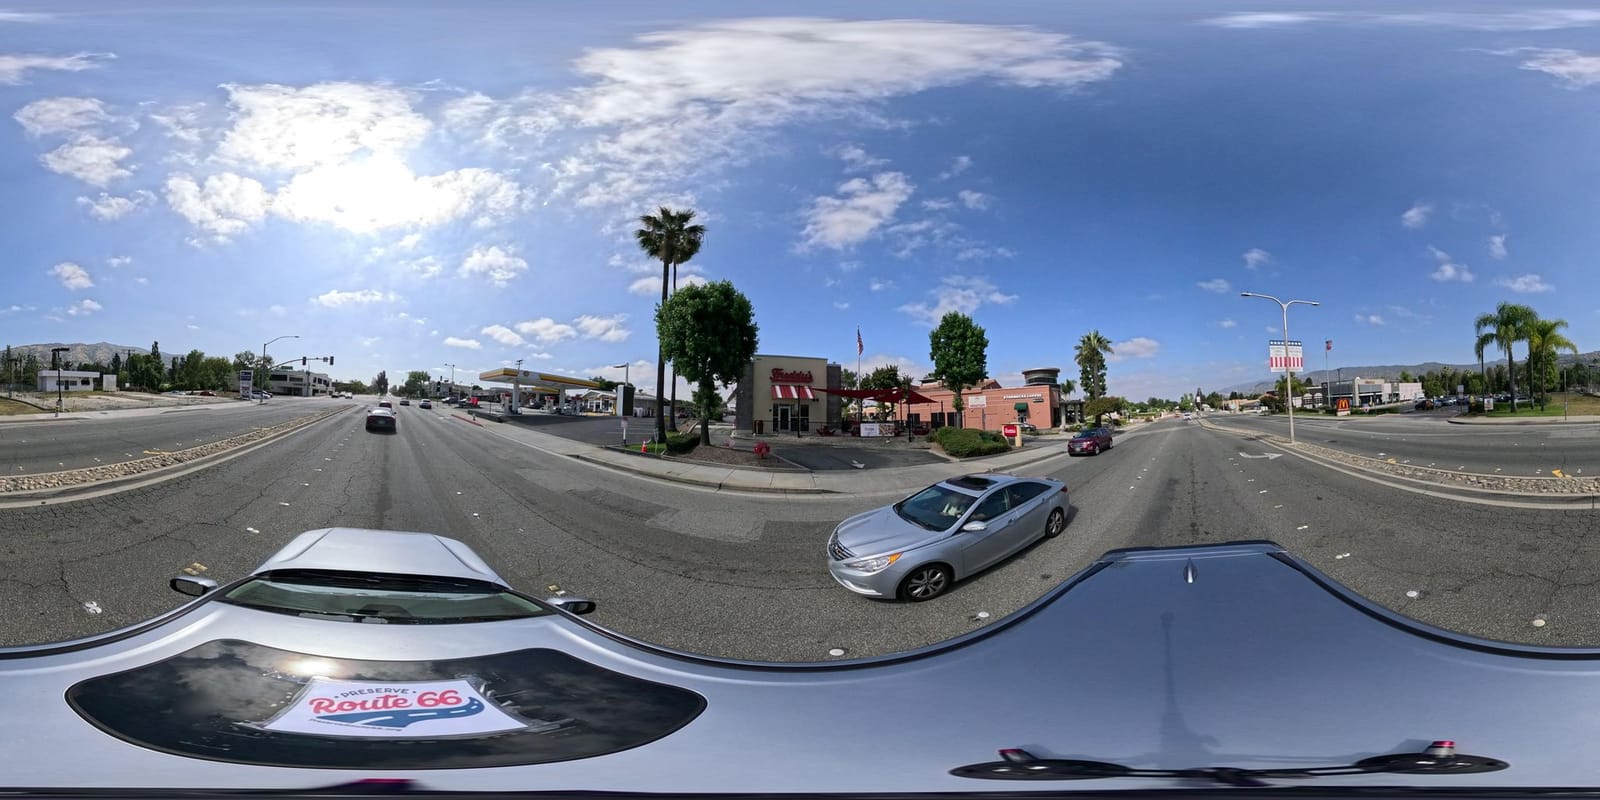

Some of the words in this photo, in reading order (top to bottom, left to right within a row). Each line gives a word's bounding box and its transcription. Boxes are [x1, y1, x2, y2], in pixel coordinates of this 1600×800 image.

[341, 688, 409, 697] PRESERVE
[309, 695, 412, 713] Route
[417, 690, 462, 707] 66
